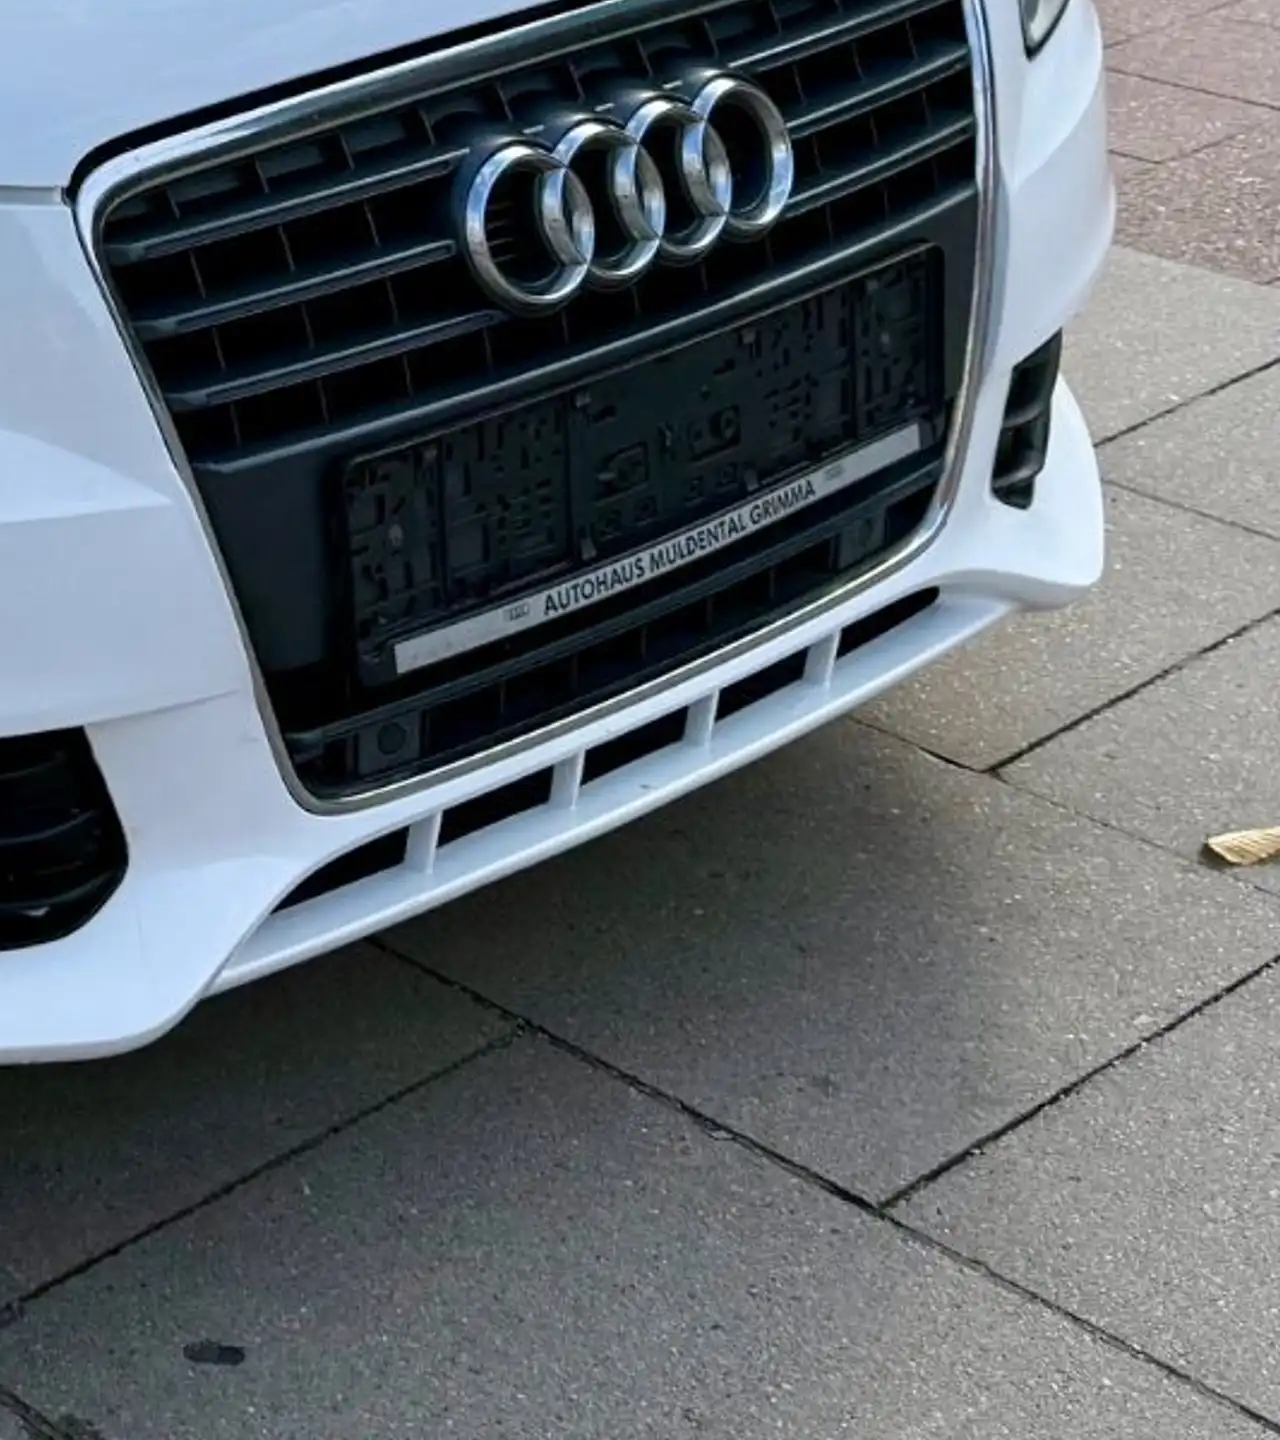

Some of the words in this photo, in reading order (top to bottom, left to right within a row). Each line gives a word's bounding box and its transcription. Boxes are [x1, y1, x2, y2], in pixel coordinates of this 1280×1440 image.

[543, 556, 646, 616] AUTOHAUS
[648, 515, 747, 574] MULDENTAL
[749, 479, 817, 526] GRIMMA
